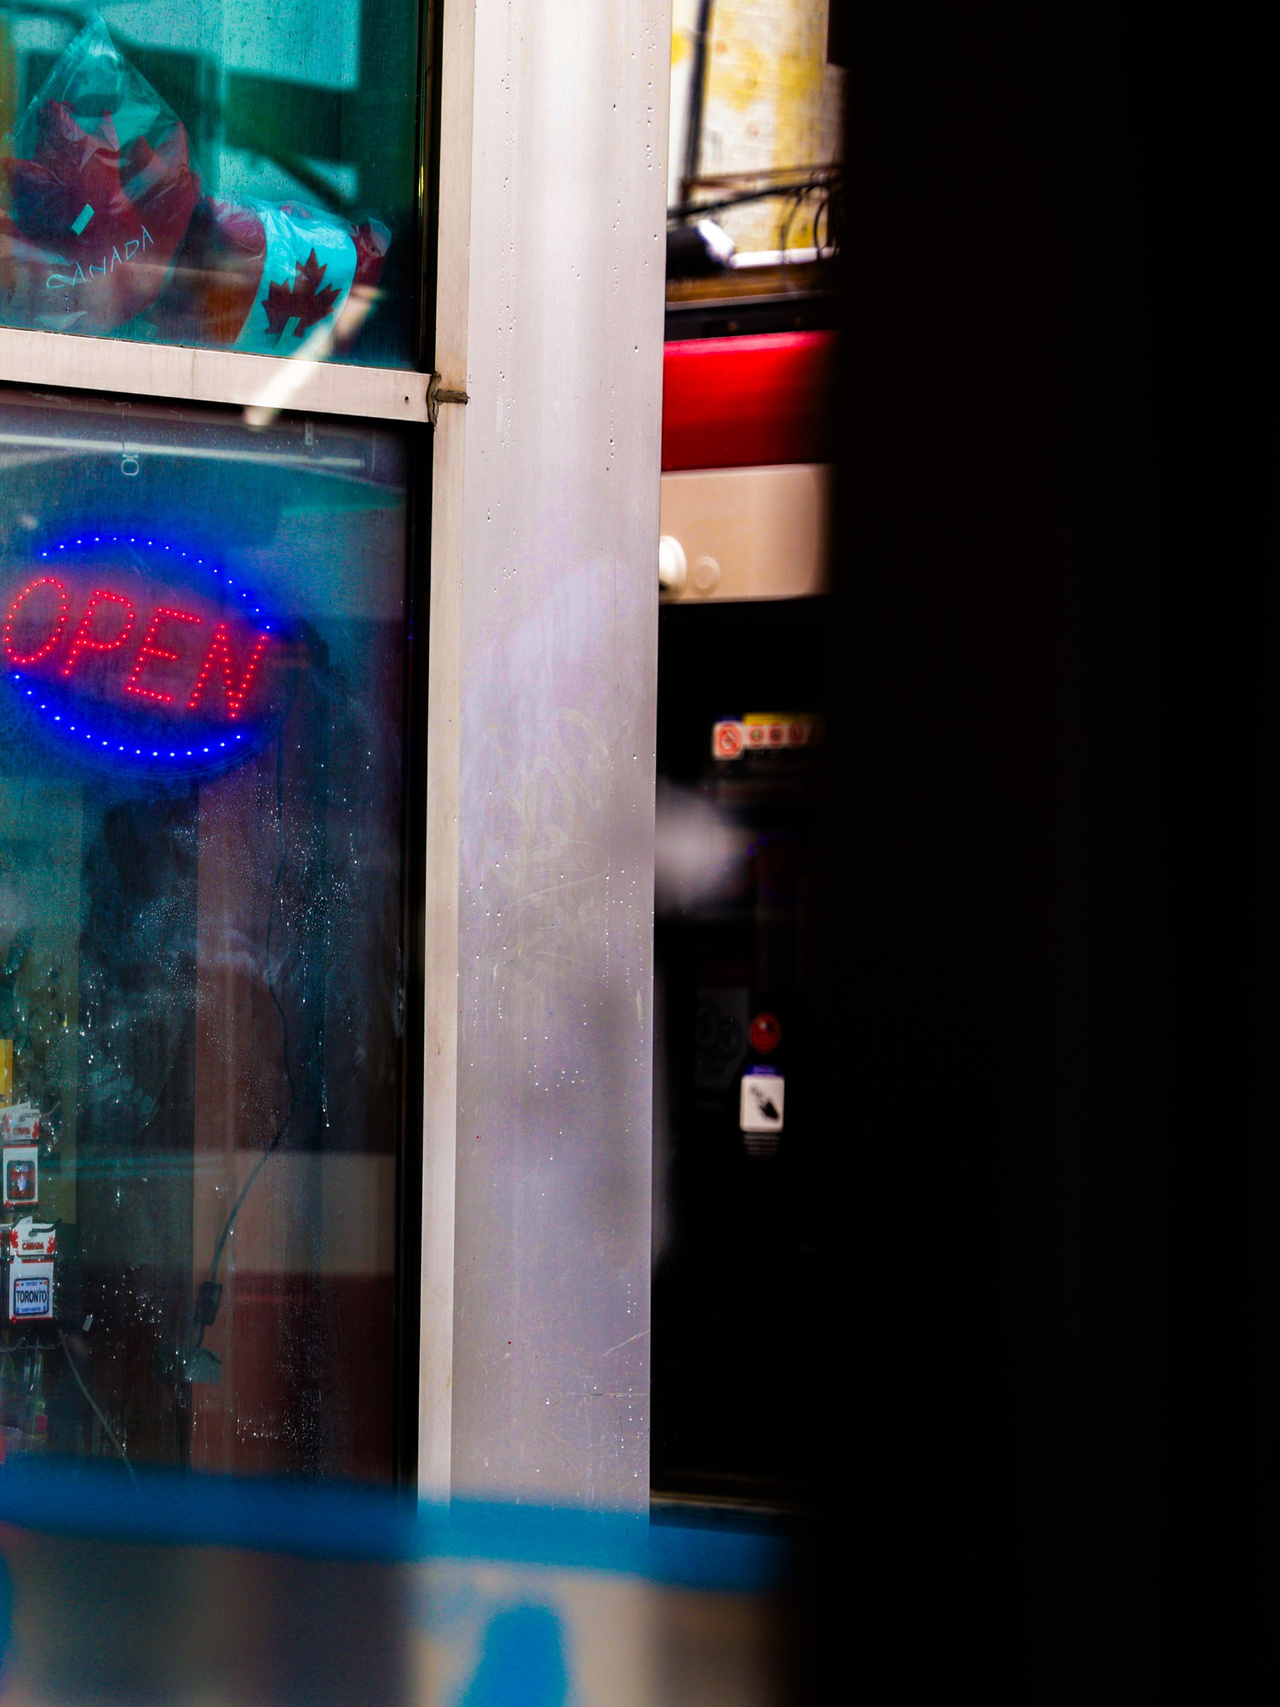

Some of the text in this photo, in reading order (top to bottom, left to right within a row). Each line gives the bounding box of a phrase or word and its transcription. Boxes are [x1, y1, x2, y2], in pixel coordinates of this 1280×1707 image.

[46, 224, 154, 289] CANADA
[3, 576, 269, 719] OPEN
[16, 1290, 48, 1304] TORONTO
